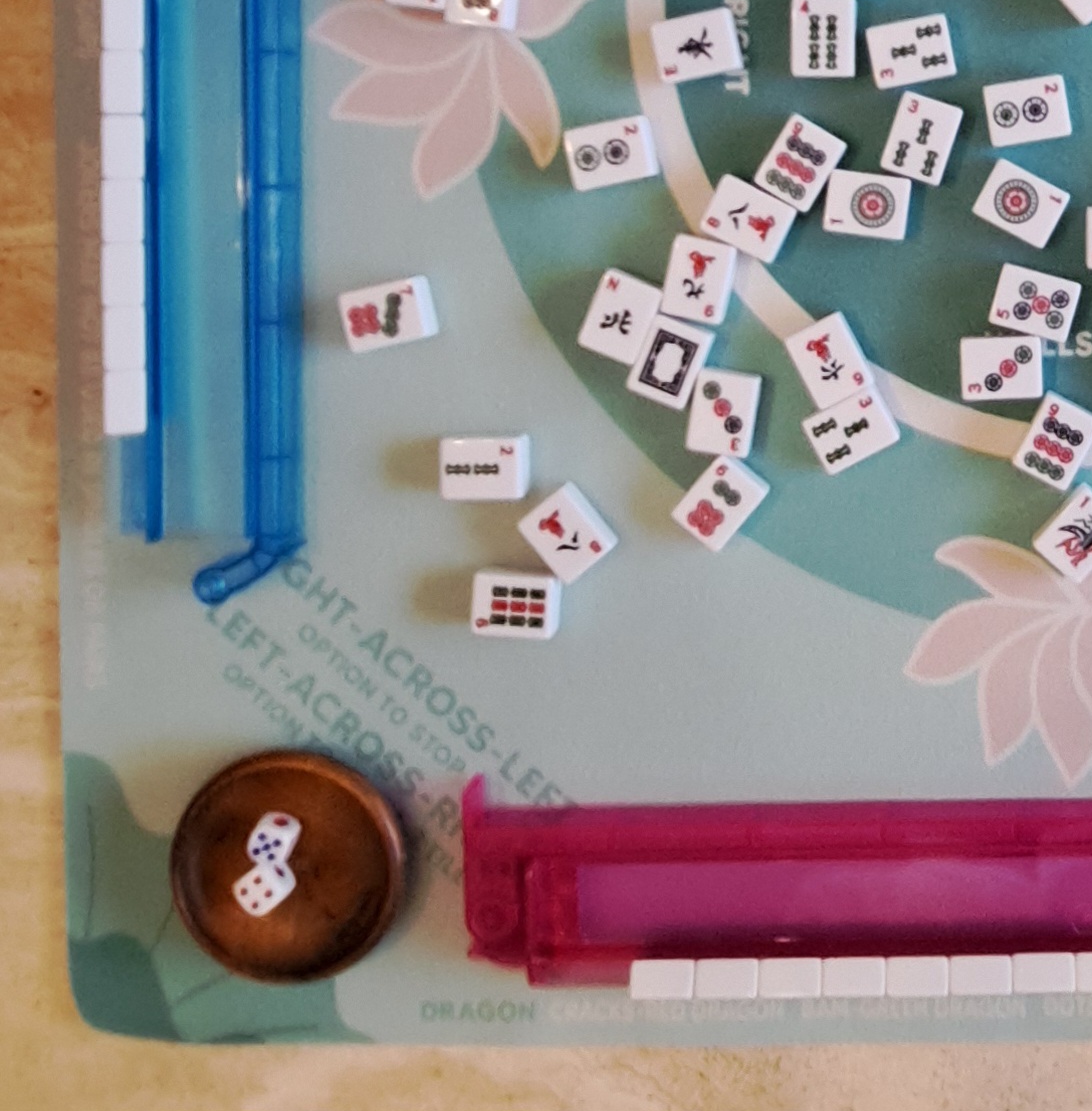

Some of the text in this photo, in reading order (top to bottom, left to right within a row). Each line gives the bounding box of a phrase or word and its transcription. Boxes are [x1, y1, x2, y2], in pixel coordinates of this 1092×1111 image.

[800, 0, 808, 14] 4
[880, 68, 894, 79] 3
[1044, 84, 1058, 94] 2
[908, 100, 919, 114] 3
[624, 125, 638, 136] 2
[1049, 195, 1062, 205] 1
[707, 217, 719, 228] 8
[607, 277, 619, 290] N
[703, 304, 714, 318] 9
[996, 309, 1009, 318] 5
[600, 309, 631, 335] 北
[852, 372, 864, 386] 6
[968, 383, 982, 393] 3
[859, 397, 872, 409] 3
[500, 446, 514, 456] 2
[730, 439, 738, 452] 3
[1079, 496, 1090, 509] 1
[298, 623, 466, 773] OPTION TO STOP
[421, 999, 535, 1023] DRAGON
